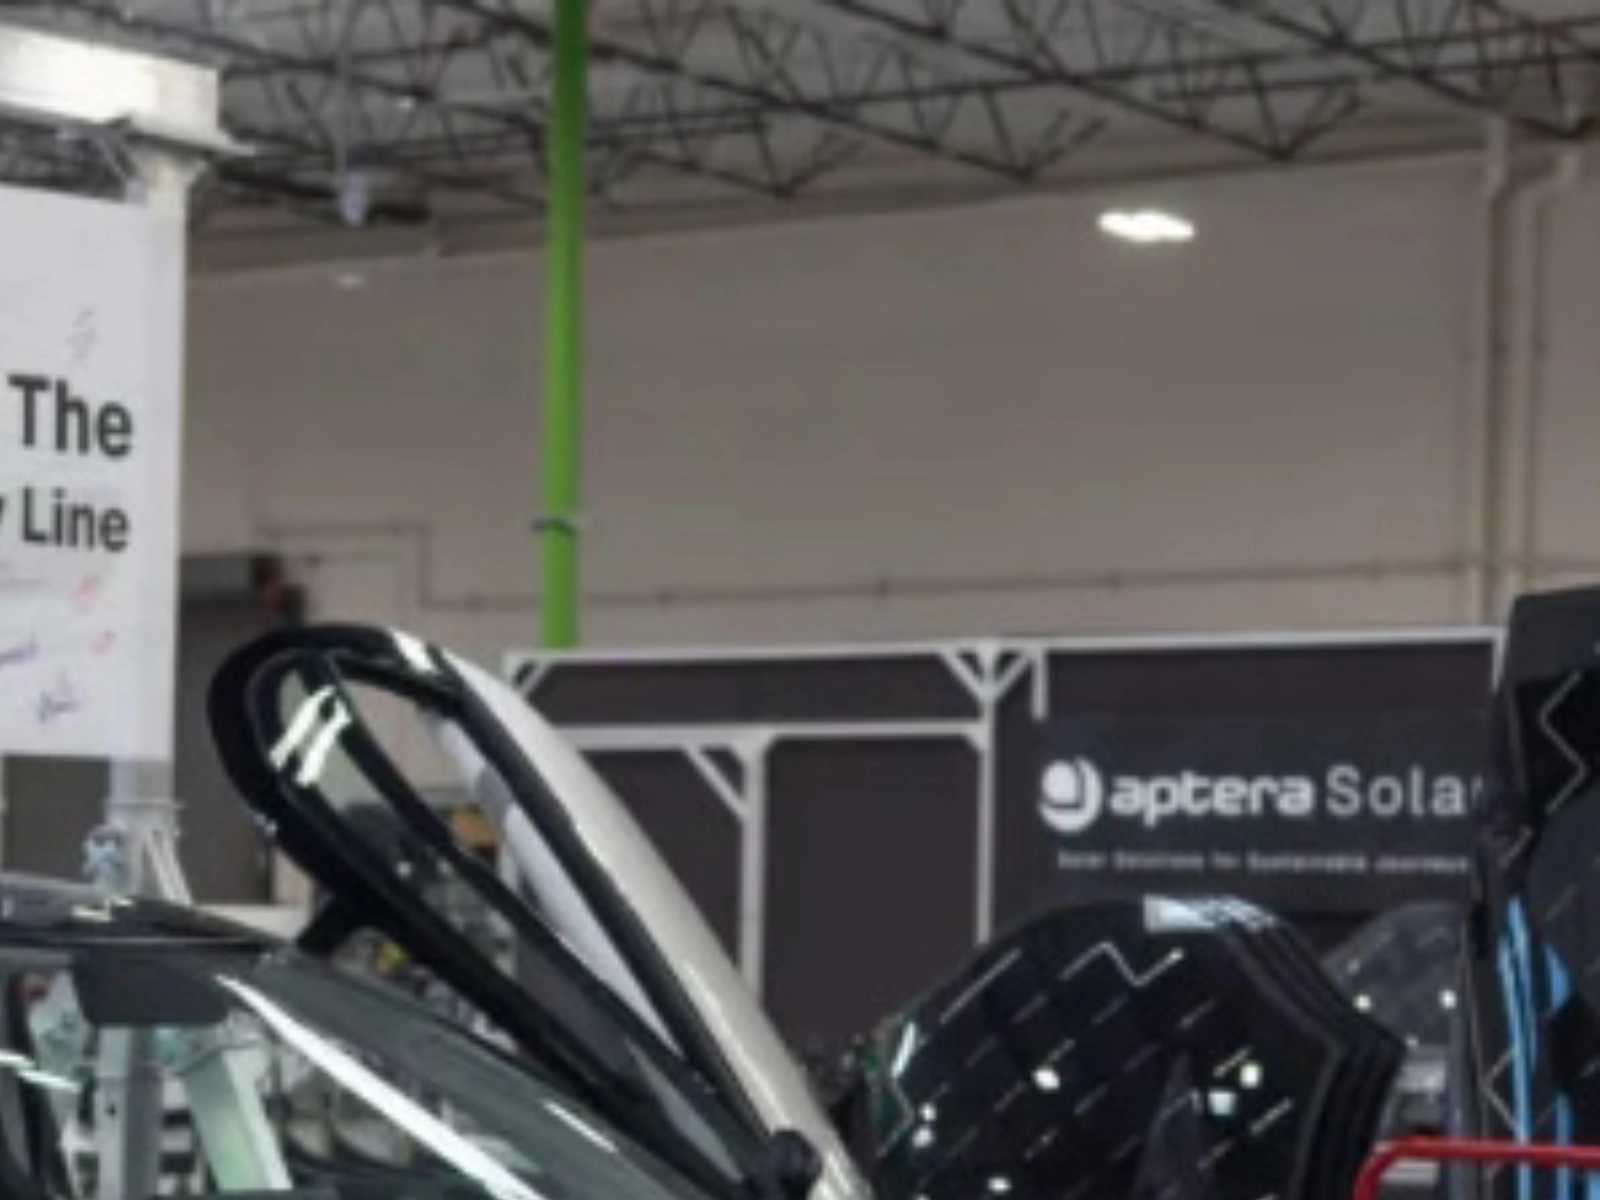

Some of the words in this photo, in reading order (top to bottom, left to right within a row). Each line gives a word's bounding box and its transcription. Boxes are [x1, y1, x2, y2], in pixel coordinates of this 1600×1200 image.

[8, 374, 133, 459] The
[21, 486, 129, 553] Line
[1108, 770, 1317, 828] aptera
